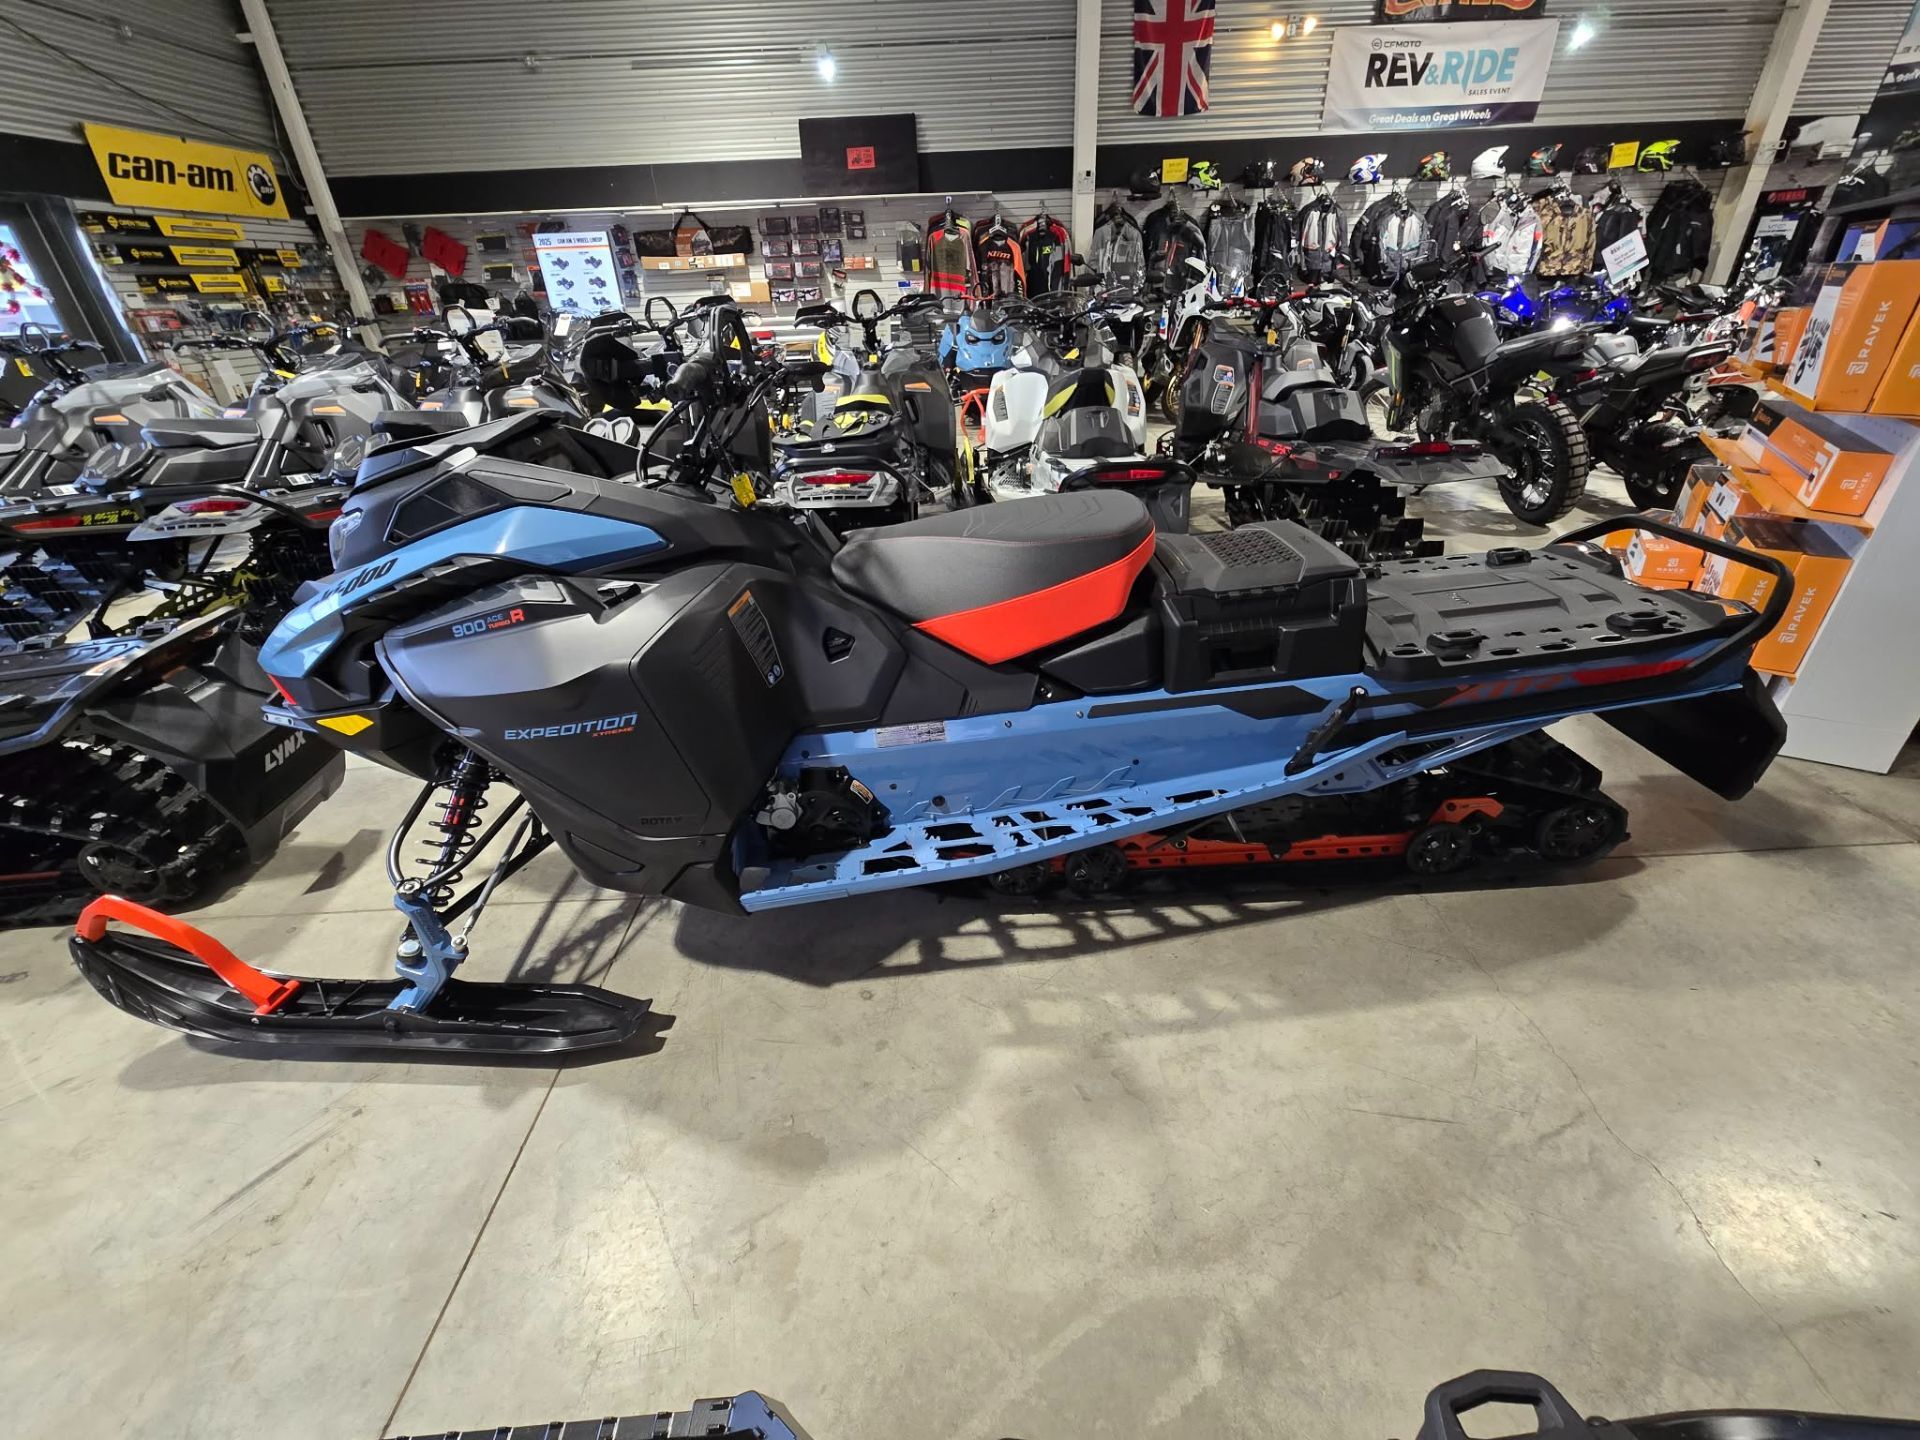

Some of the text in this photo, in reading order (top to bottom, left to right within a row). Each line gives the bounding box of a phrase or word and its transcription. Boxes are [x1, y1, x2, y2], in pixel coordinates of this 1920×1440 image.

[1384, 39, 1422, 48] CFMOTO
[1467, 86, 1511, 96] SALES EVENT
[1368, 107, 1492, 125] Great Deals on Great Wheels
[107, 152, 235, 193] can-am
[260, 186, 275, 195] BRP
[538, 238, 552, 246] 2025
[1857, 299, 1893, 359] RAVEK
[1788, 586, 1817, 632] RAVEK
[452, 608, 525, 638] 900 ACE TURBO R
[504, 712, 639, 741] EXPEDITION
[591, 726, 635, 738] XTREME
[264, 730, 307, 773] LYNX
